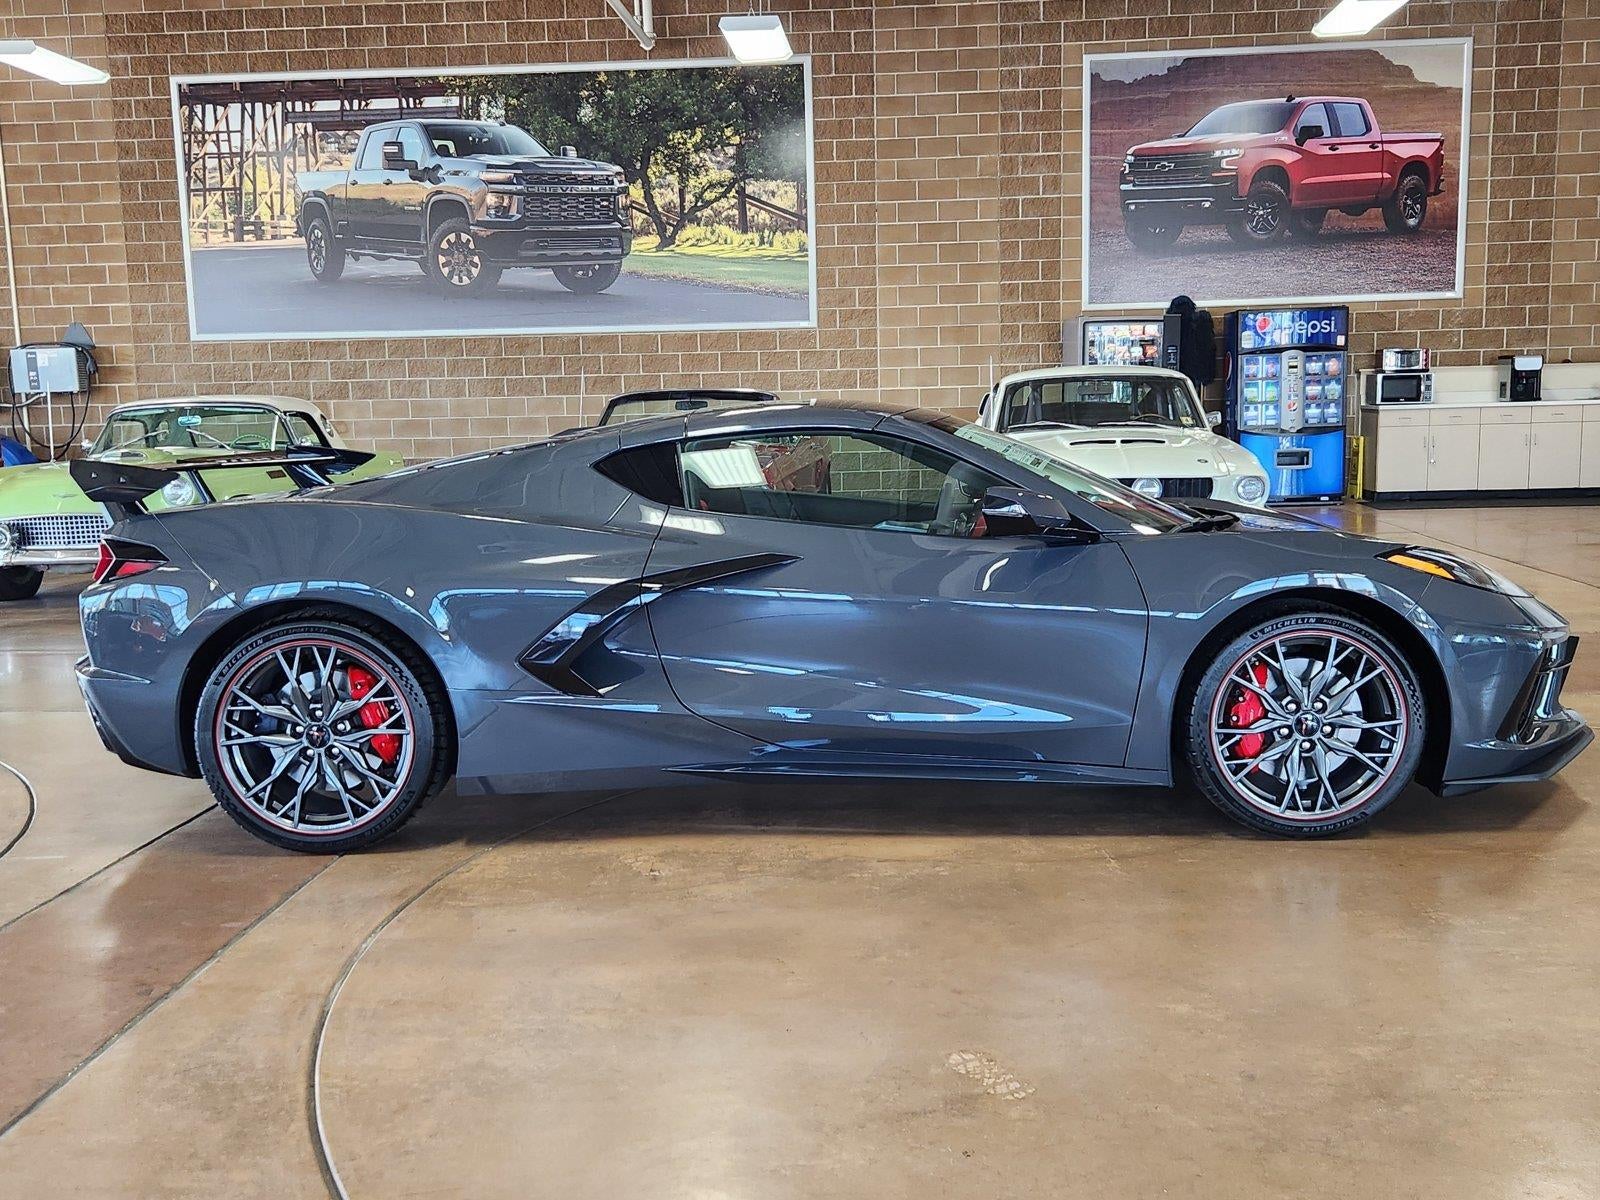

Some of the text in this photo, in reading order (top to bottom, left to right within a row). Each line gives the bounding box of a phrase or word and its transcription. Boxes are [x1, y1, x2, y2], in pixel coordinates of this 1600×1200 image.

[1282, 316, 1335, 338] pepsi
[1264, 617, 1316, 634] MICHELIN
[1342, 622, 1360, 632] SPORT
[222, 637, 264, 675] MICHELIN
[288, 626, 308, 634] SPORT
[1302, 818, 1354, 832] MICHELIN
